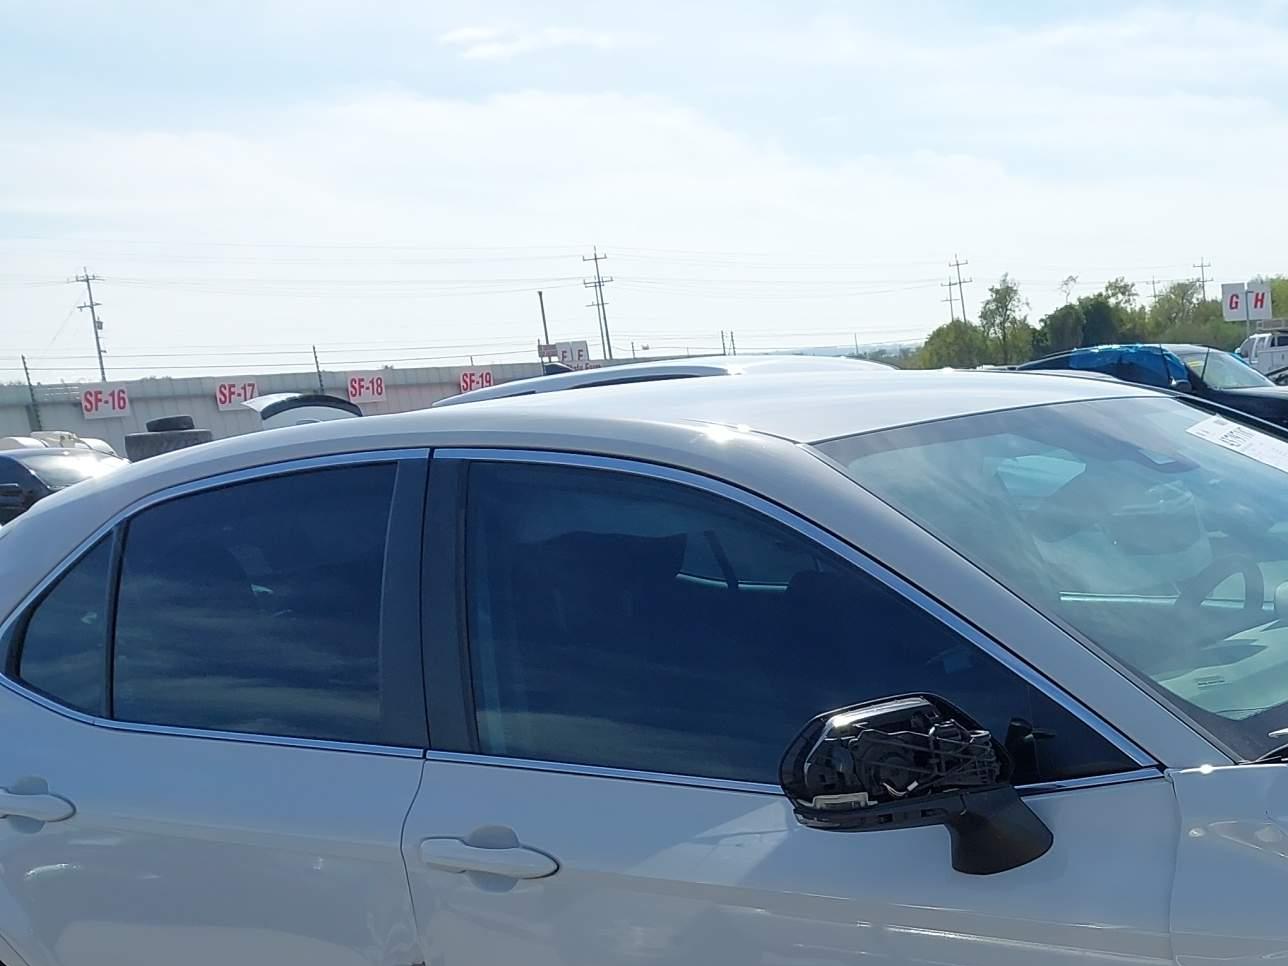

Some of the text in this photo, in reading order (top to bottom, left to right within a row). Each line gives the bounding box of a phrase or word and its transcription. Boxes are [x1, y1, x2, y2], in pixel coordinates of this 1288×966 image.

[1229, 292, 1265, 310] G H
[350, 376, 383, 397] SF-18
[462, 372, 492, 392] SF-19
[84, 389, 126, 412] SF-16
[219, 383, 255, 405] SF-17
